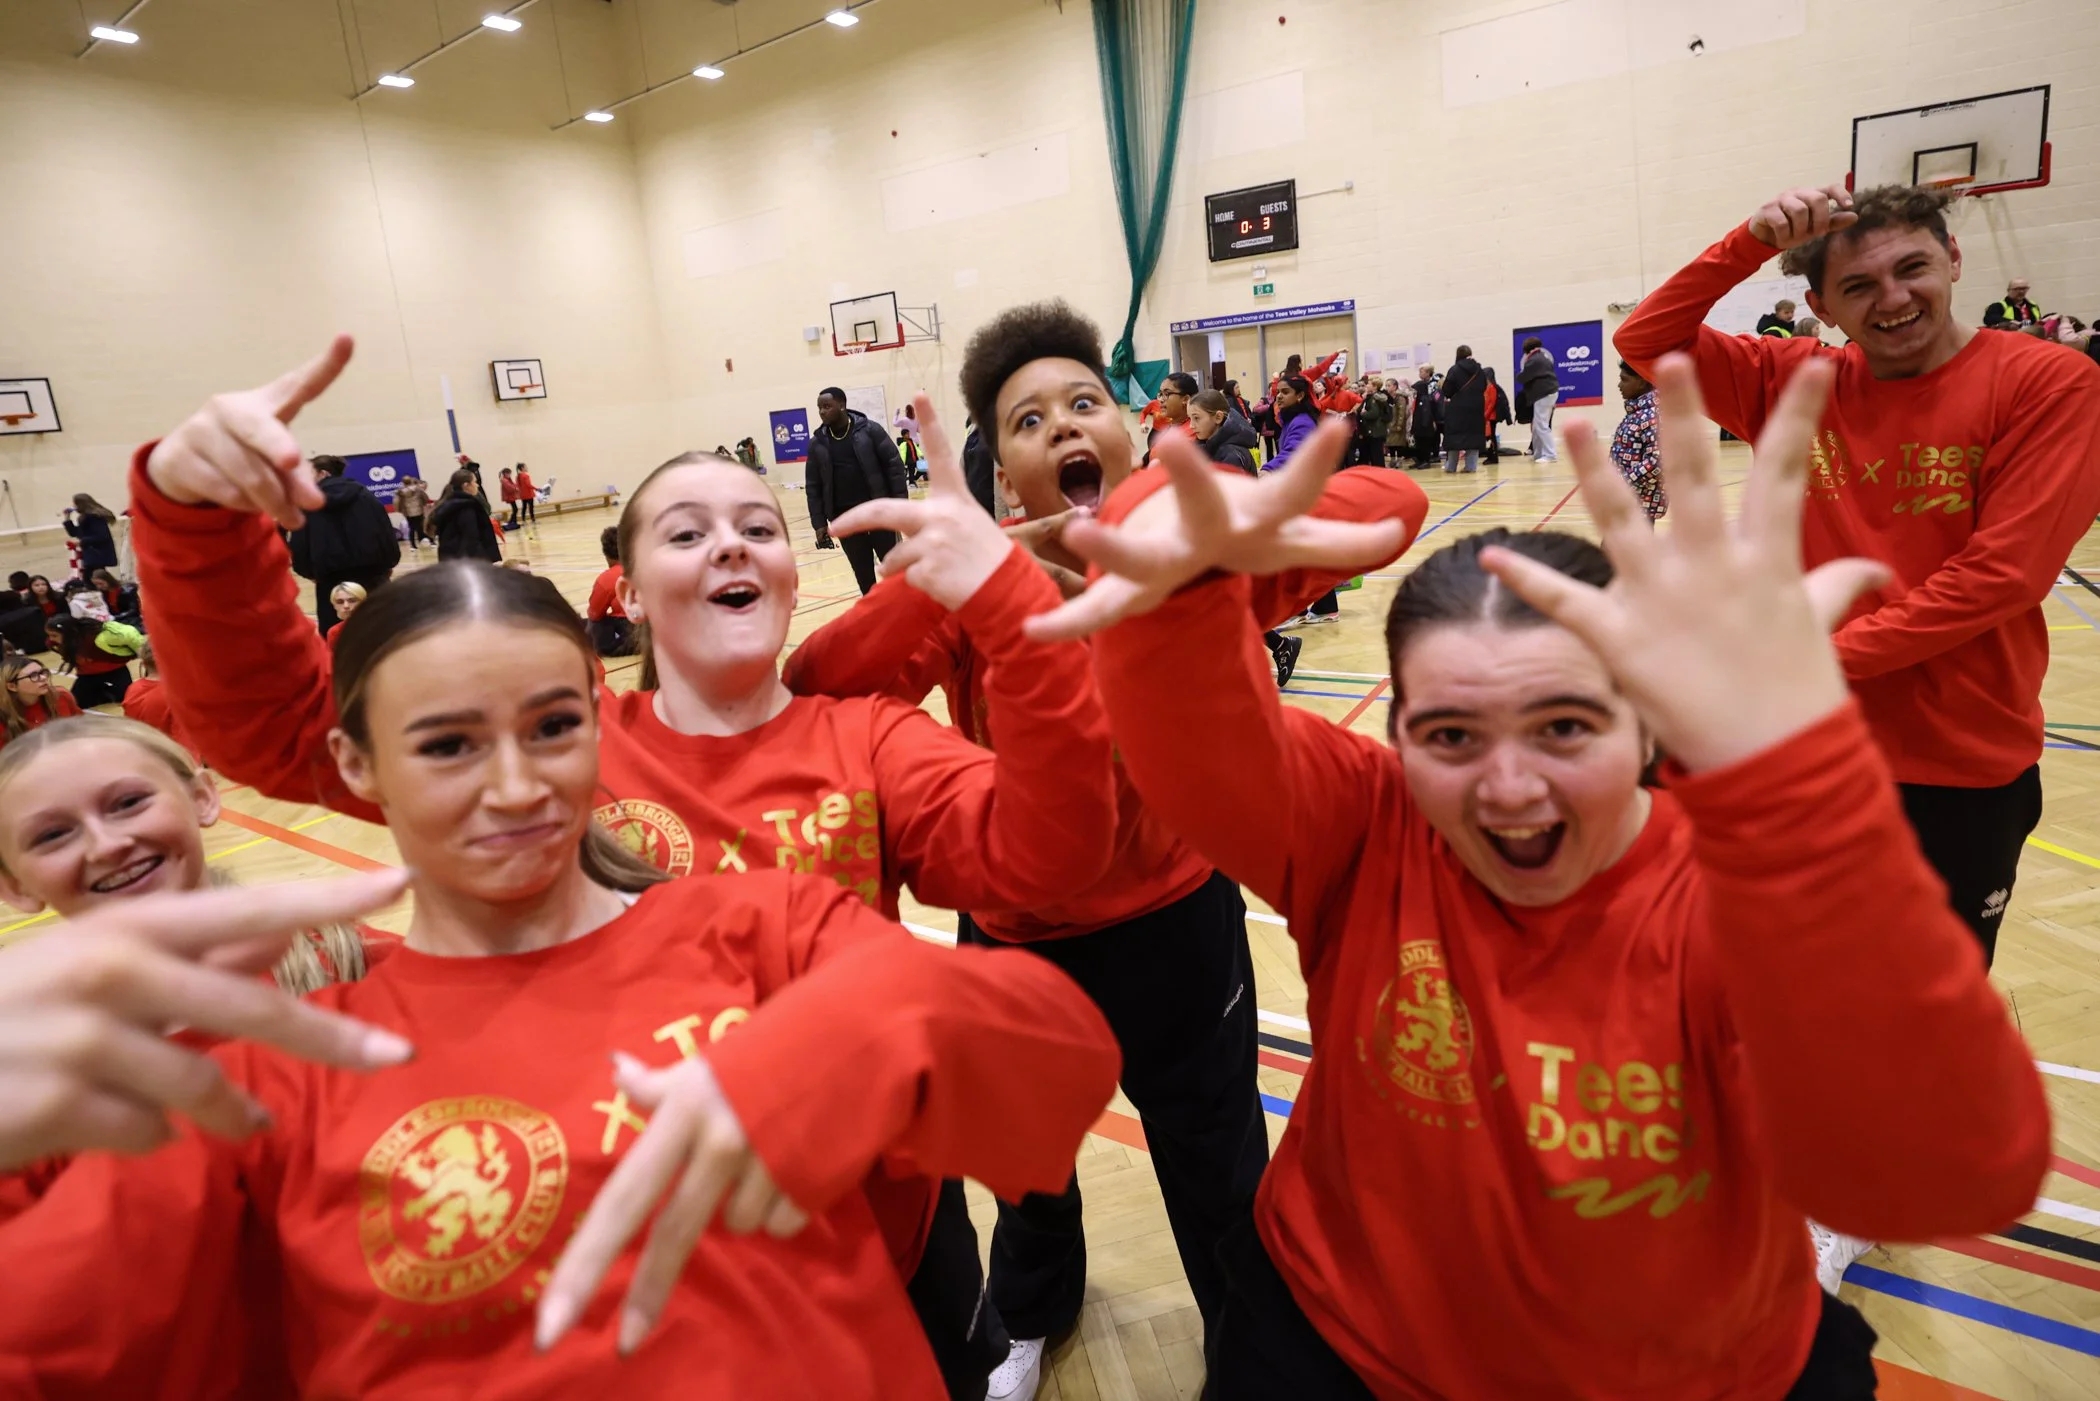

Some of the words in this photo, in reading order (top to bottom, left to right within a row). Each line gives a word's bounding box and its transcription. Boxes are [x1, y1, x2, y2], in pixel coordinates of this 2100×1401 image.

[1214, 211, 1235, 223] HOME
[1260, 201, 1288, 215] GUESTS
[1263, 216, 1270, 230] 3
[1203, 319, 1226, 327] Welcome
[1307, 305, 1335, 313] Mohawks
[1899, 442, 1985, 469] Tees
[1896, 468, 1970, 489] Danc
[596, 803, 687, 846] DLESBROUGH
[1526, 1102, 1683, 1164] Danc
